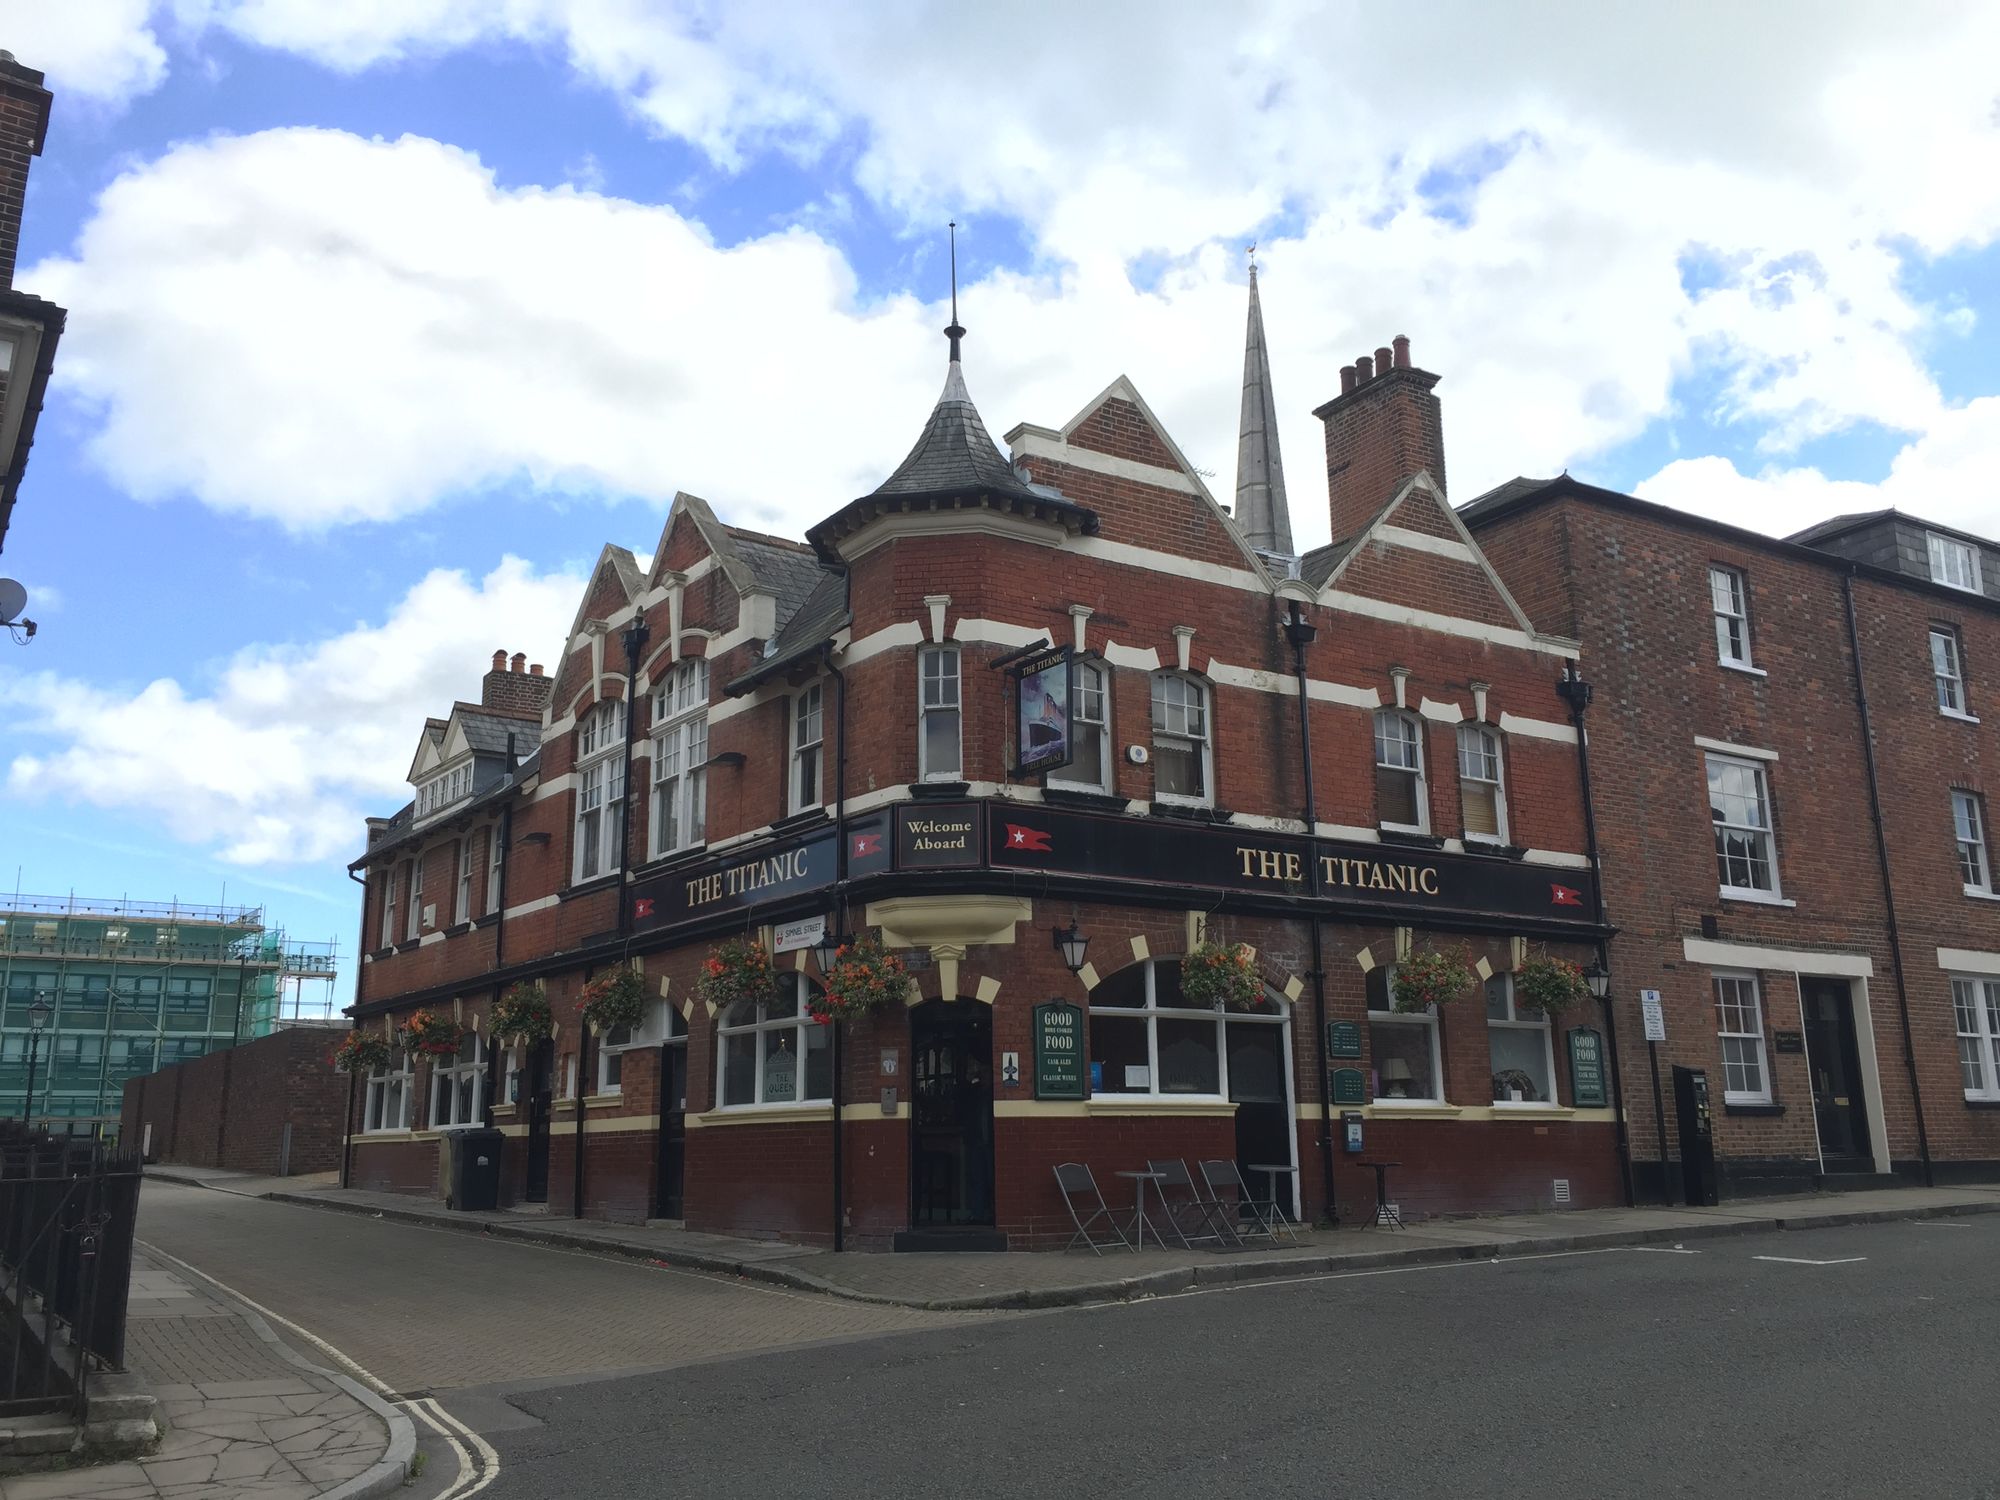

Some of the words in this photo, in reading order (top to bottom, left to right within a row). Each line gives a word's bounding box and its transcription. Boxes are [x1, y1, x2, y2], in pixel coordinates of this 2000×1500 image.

[1023, 664, 1036, 676] THE
[1036, 652, 1065, 671] TITANIC
[907, 820, 972, 834] Welcome
[913, 835, 966, 850] Aboard
[686, 872, 723, 907] THE
[726, 847, 808, 896] TITANIC
[1236, 847, 1303, 881] THE
[1319, 855, 1440, 895] TITANIC
[803, 922, 822, 935] STREET
[1044, 1012, 1073, 1026] GOOD
[1045, 1035, 1073, 1049] FOOD
[1574, 1036, 1595, 1048] GOOD
[1576, 1048, 1596, 1060] FOOD
[768, 1083, 794, 1094] QUEEN
